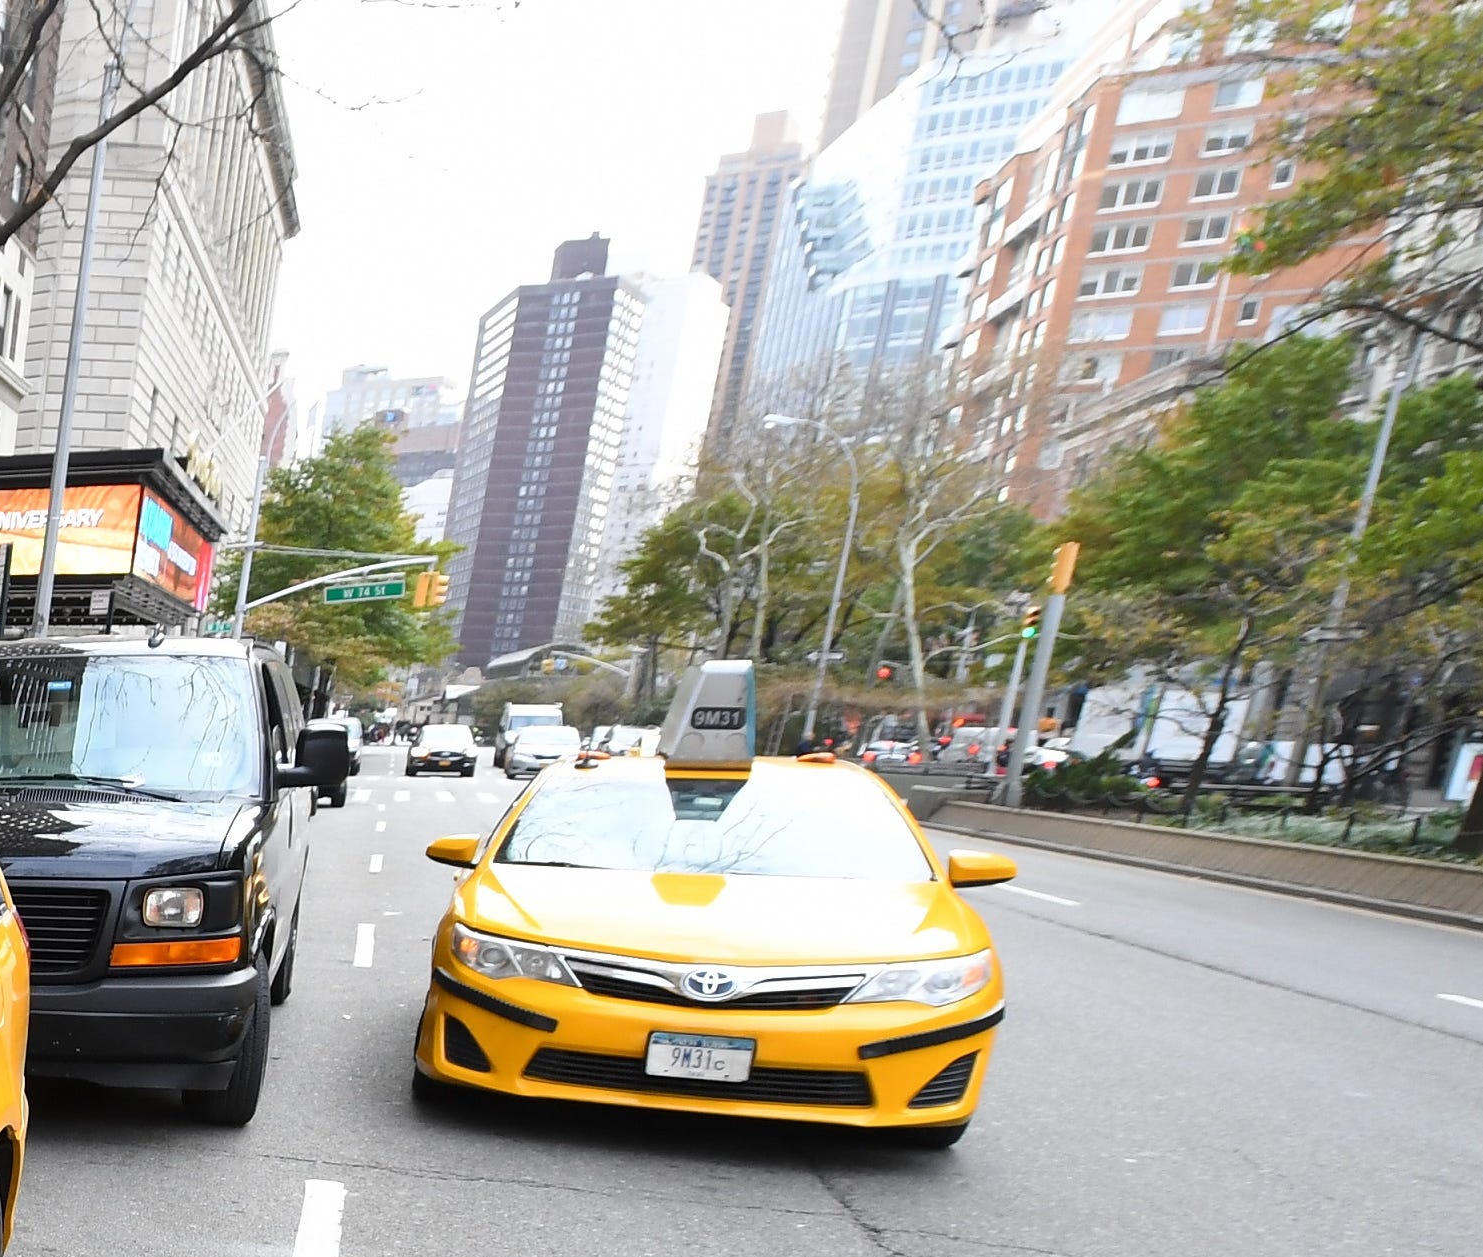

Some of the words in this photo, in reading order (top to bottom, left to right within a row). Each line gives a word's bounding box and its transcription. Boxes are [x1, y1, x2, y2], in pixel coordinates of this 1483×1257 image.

[343, 588, 354, 598] W
[359, 586, 371, 597] 74
[694, 710, 740, 726] 9M31
